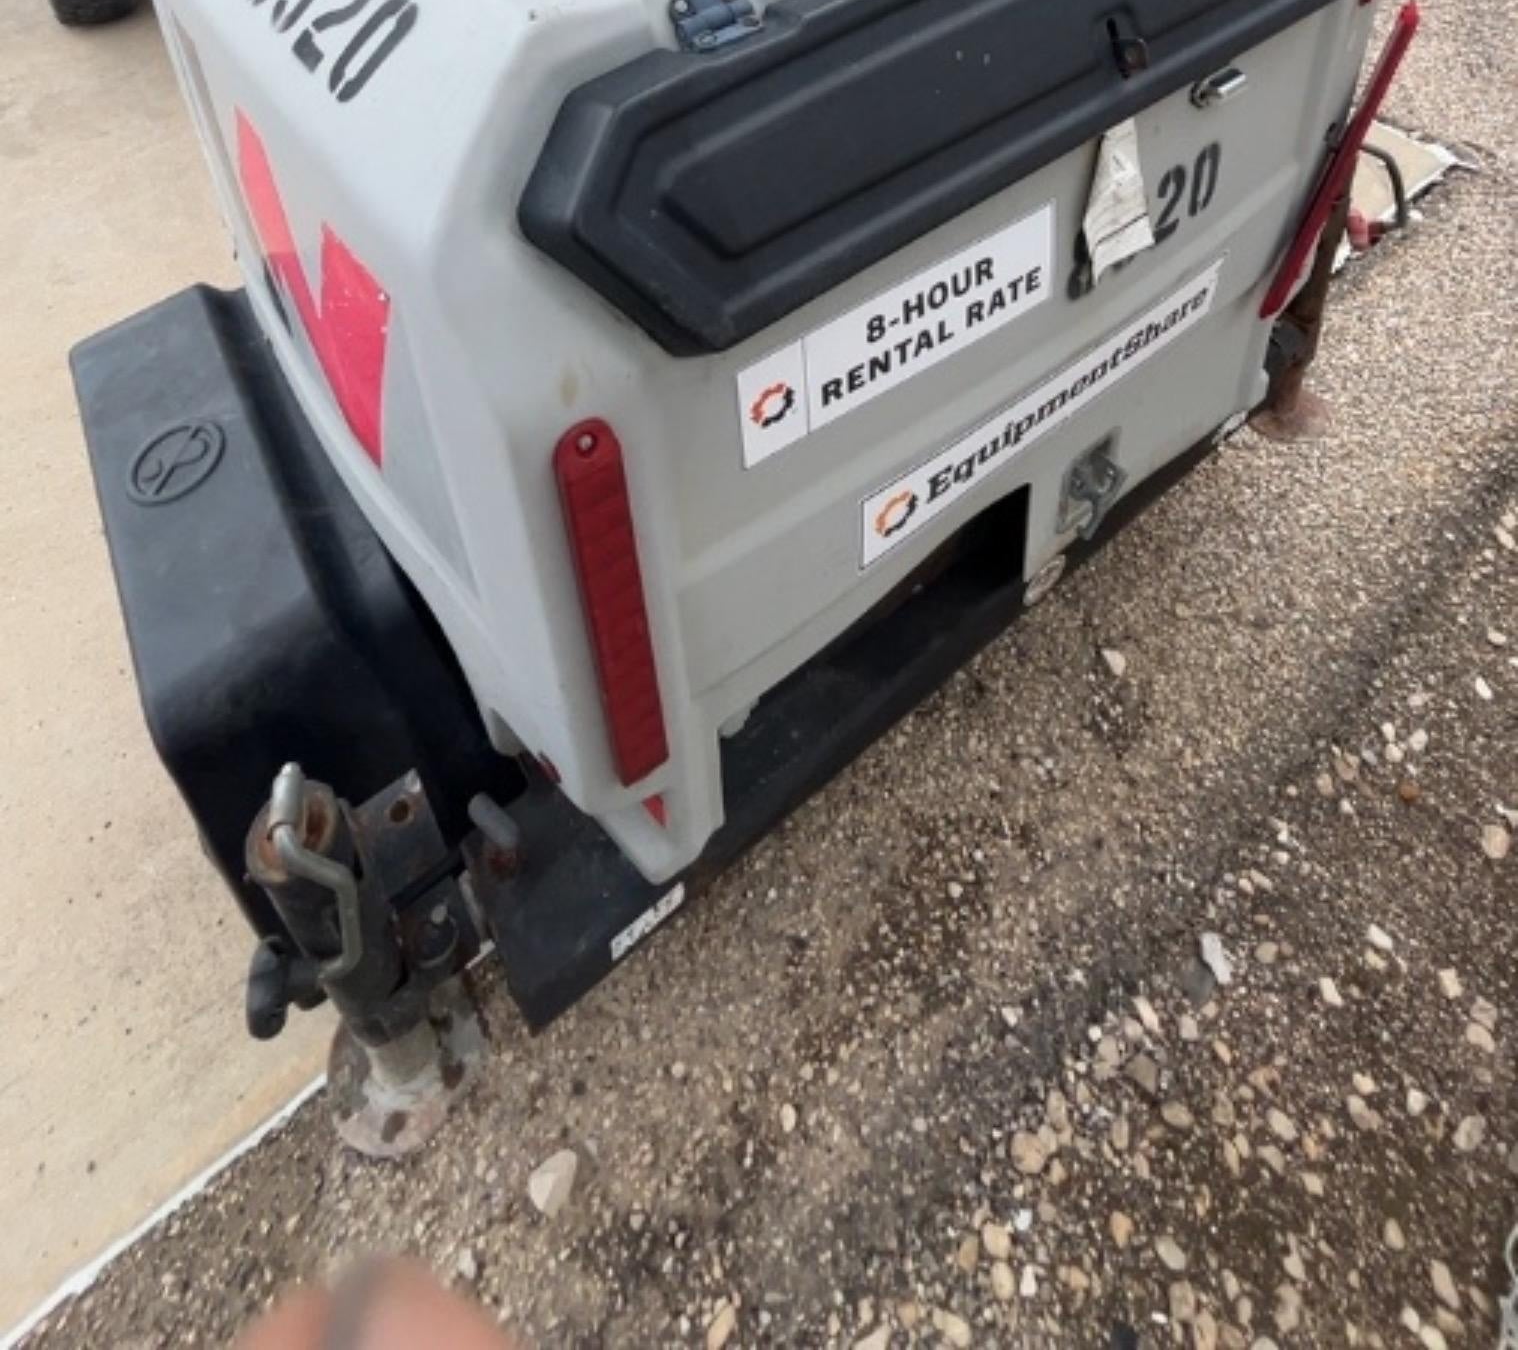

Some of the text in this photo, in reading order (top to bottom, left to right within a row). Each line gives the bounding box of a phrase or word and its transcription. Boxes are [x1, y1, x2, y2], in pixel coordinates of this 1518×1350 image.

[821, 265, 1042, 408] RENTAL RATE
[865, 256, 994, 344] 8-HOUR
[926, 286, 1209, 504] EquipmentShare
